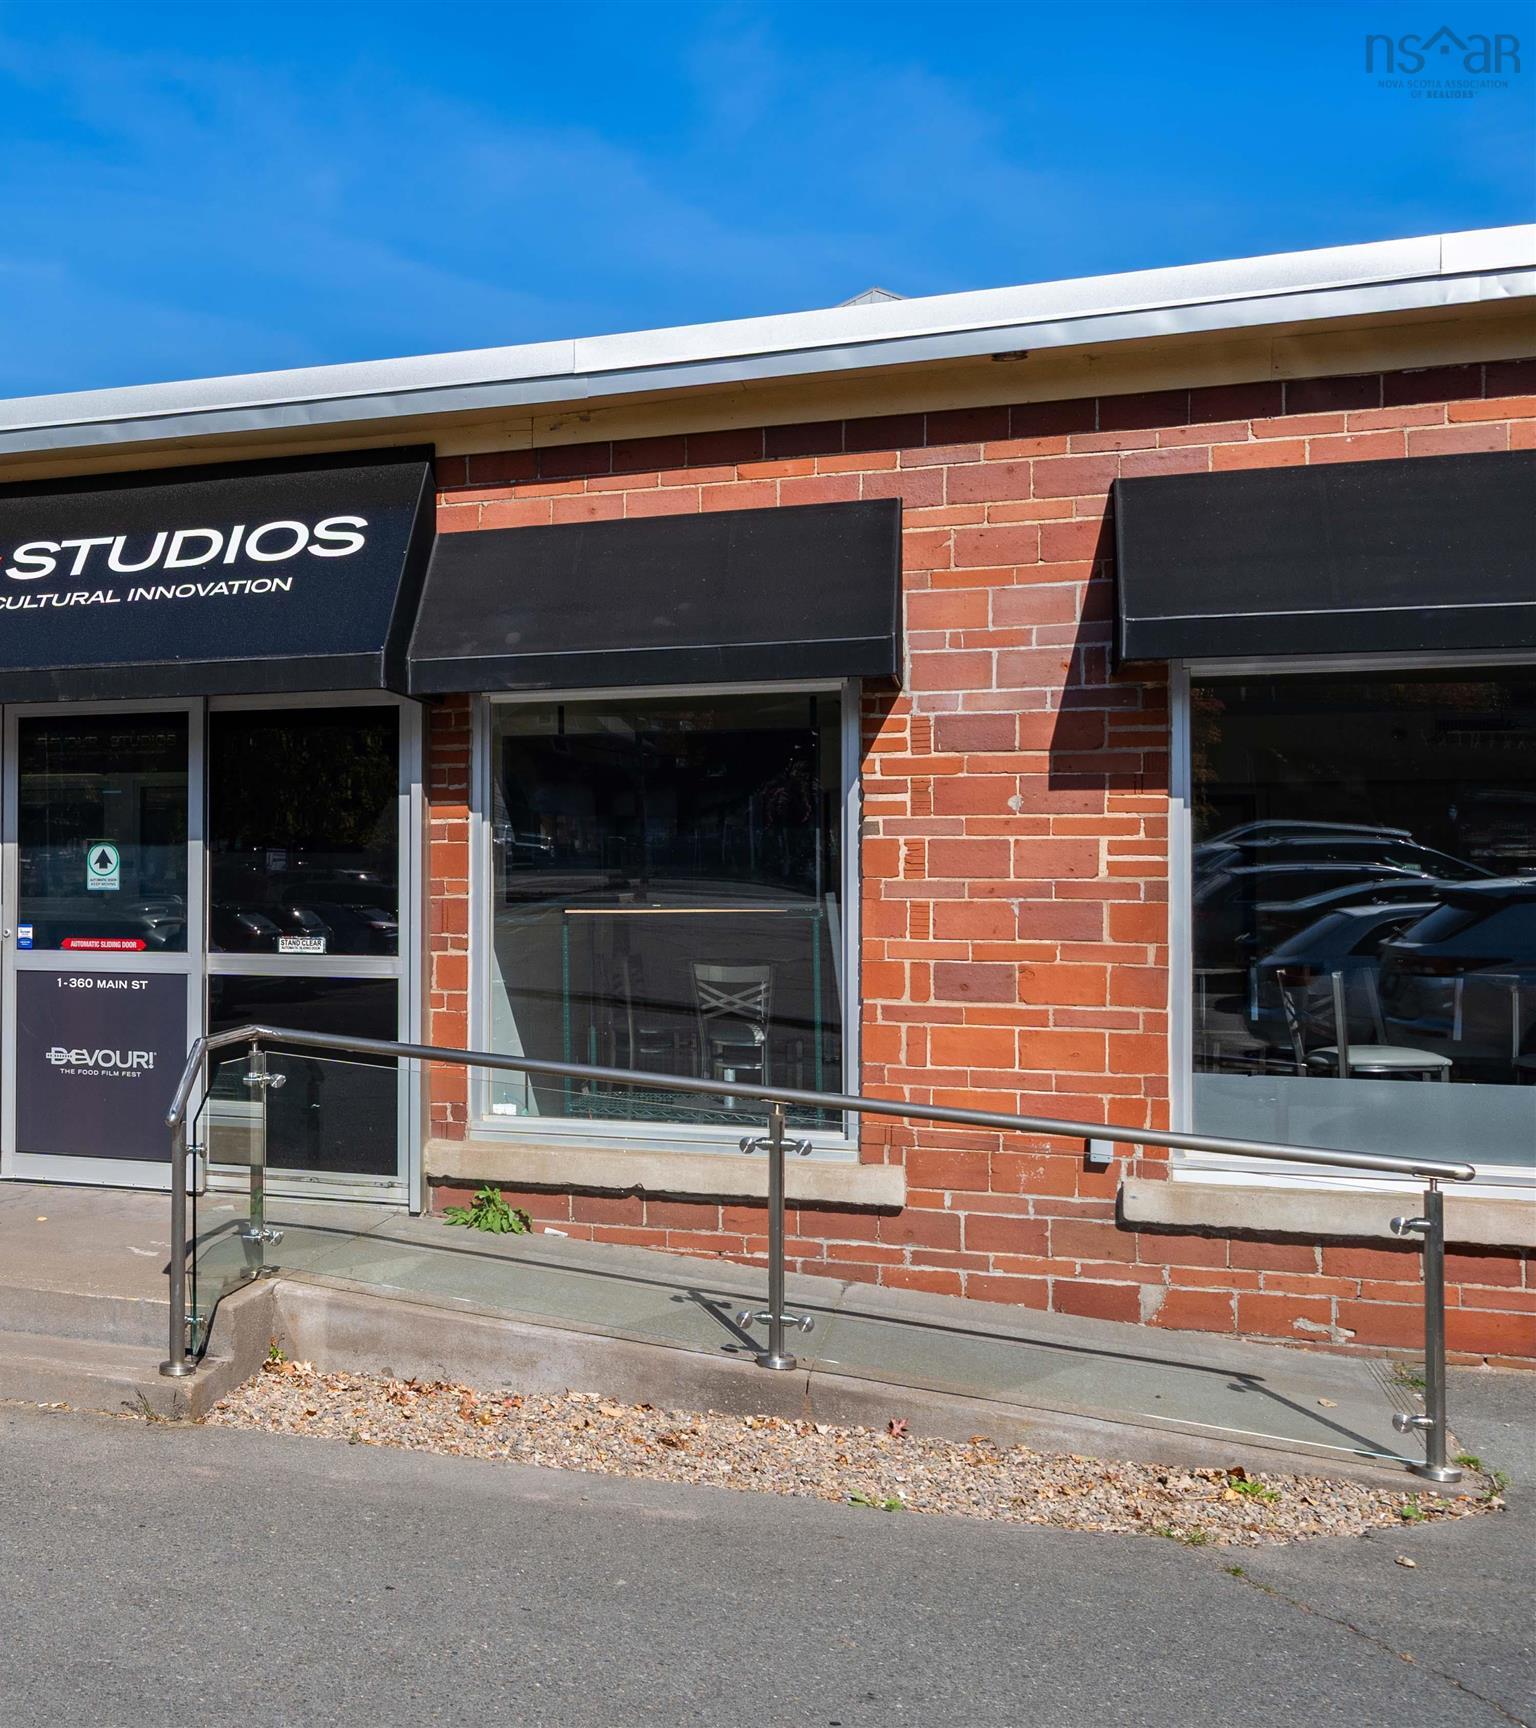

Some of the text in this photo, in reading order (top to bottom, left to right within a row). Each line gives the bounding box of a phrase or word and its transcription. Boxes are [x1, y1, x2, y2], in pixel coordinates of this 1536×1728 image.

[5, 515, 369, 580] STUDIOS
[127, 577, 293, 602] INNOVATION
[57, 977, 148, 989] 1-360 MAIN ST
[46, 1047, 154, 1069] DEVOUR!
